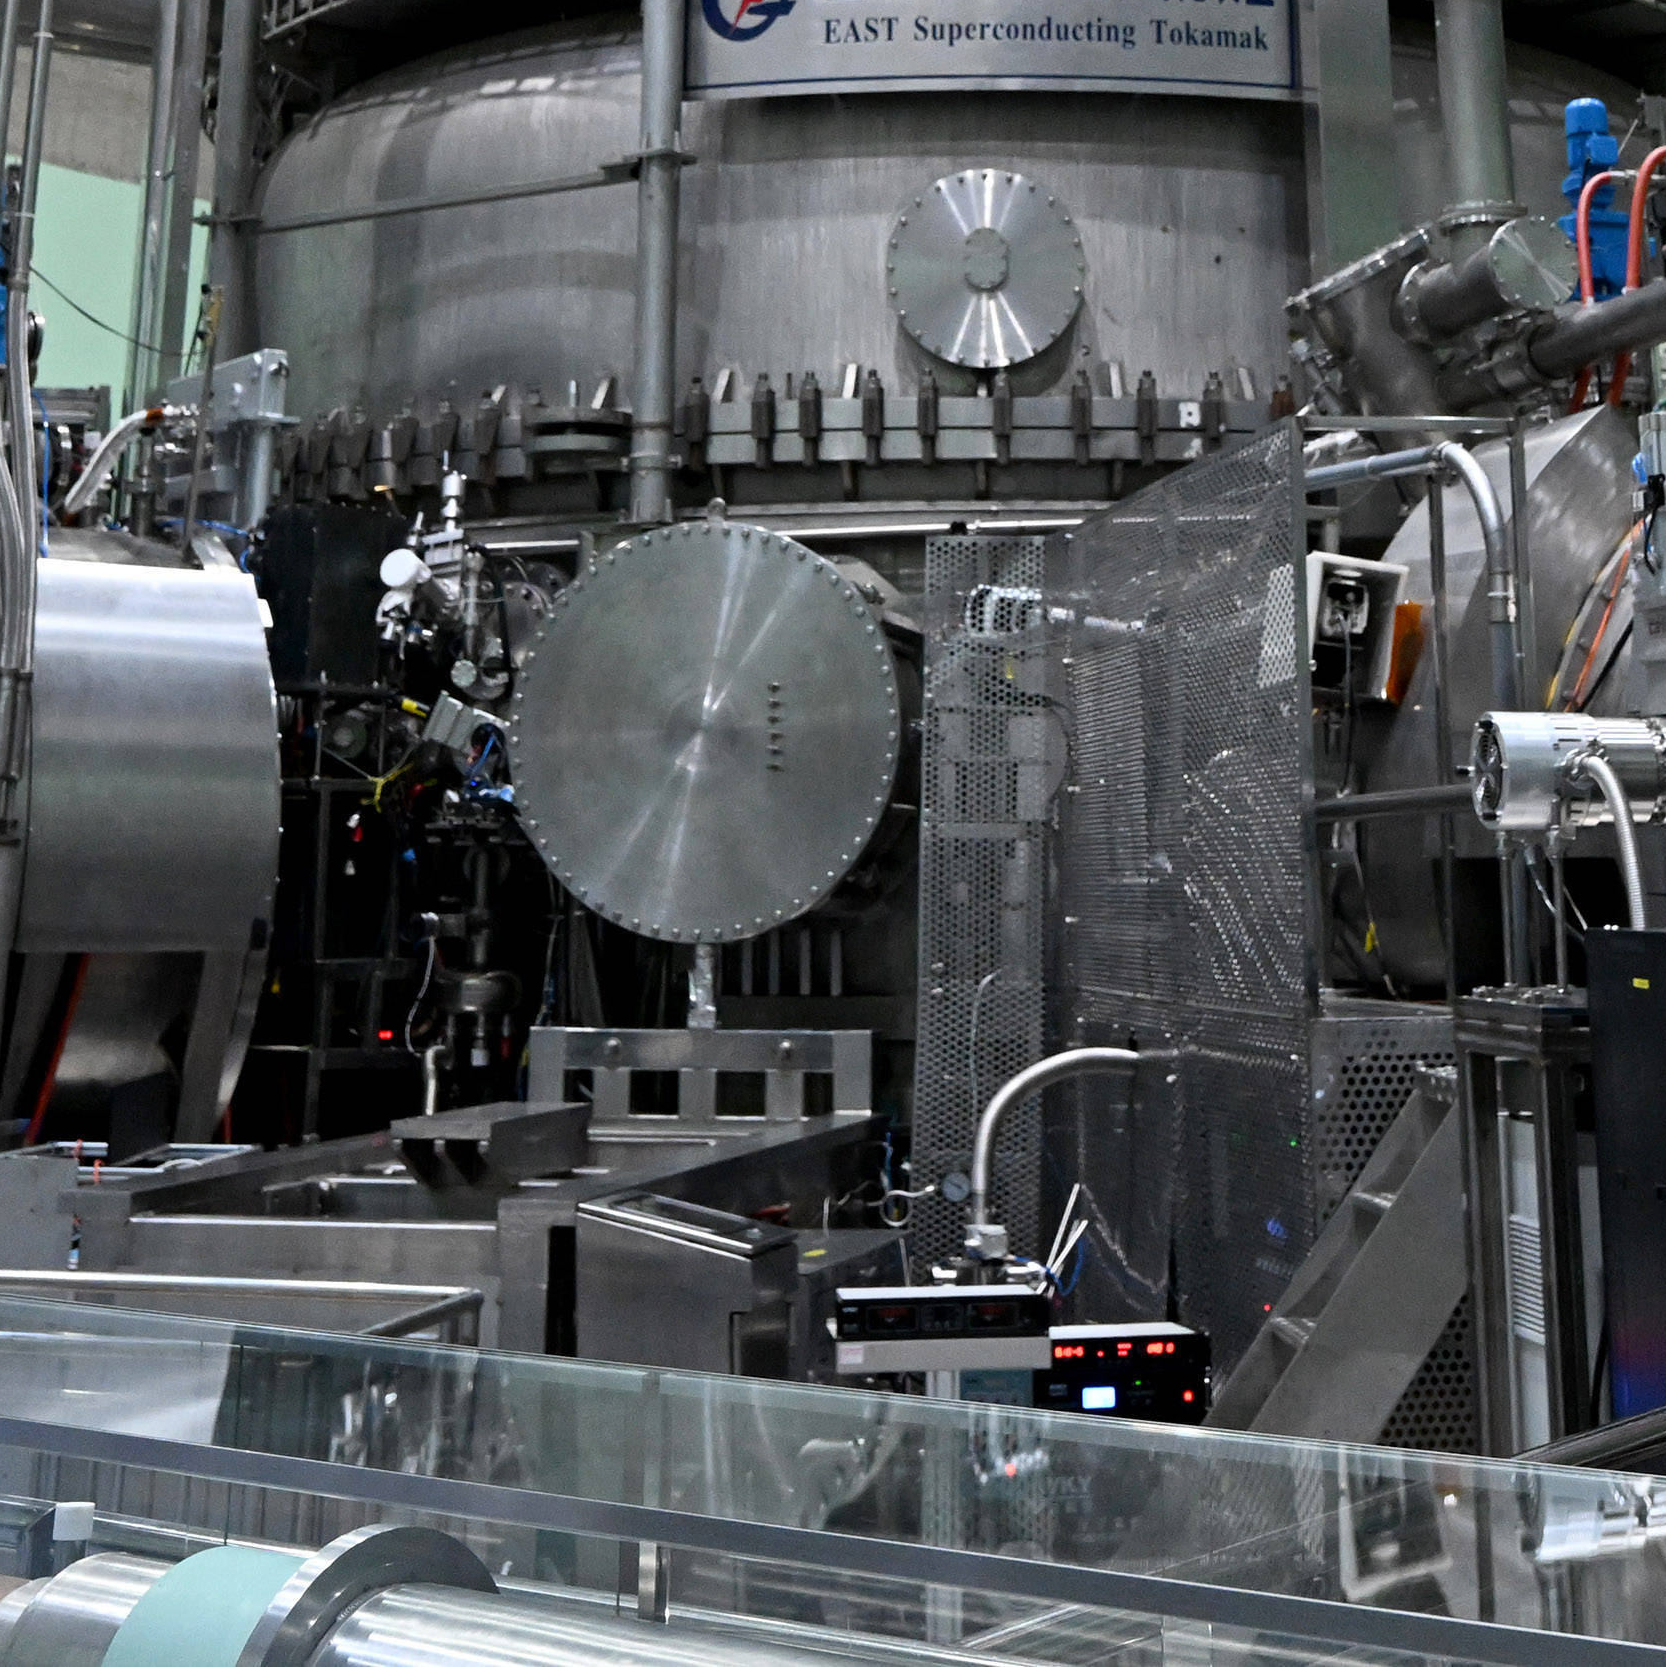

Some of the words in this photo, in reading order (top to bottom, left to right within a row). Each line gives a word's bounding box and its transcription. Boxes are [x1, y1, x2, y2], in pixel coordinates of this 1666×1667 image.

[824, 17, 899, 44] EAST
[913, 15, 1136, 50] Superconducting
[1150, 19, 1269, 51] Tokamak
